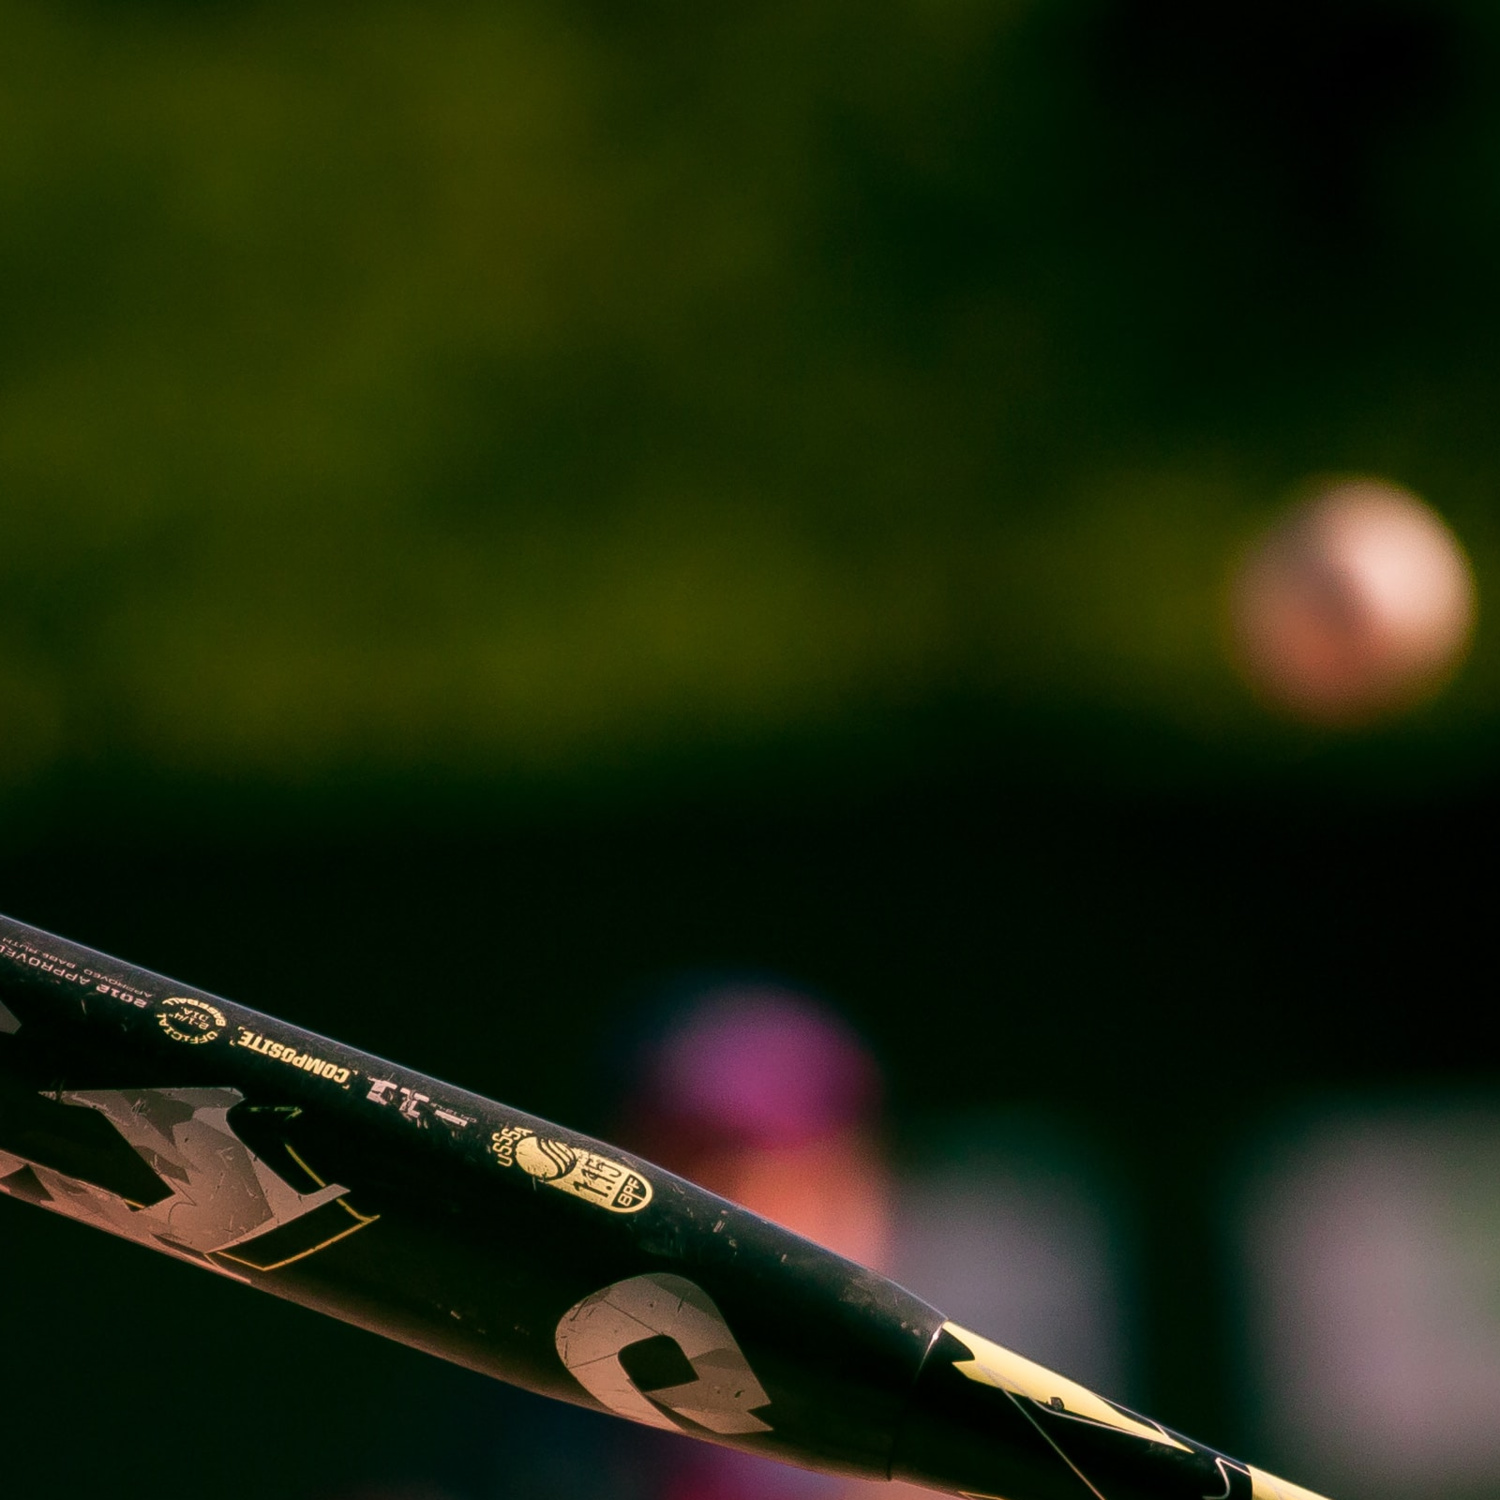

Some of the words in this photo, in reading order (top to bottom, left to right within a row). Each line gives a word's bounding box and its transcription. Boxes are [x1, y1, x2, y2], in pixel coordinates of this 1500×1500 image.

[156, 1013, 218, 1044] OFFICIAL
[237, 1030, 349, 1083] COMPOSITE
[492, 1127, 533, 1167] USSSA
[617, 1177, 641, 1207] BPF
